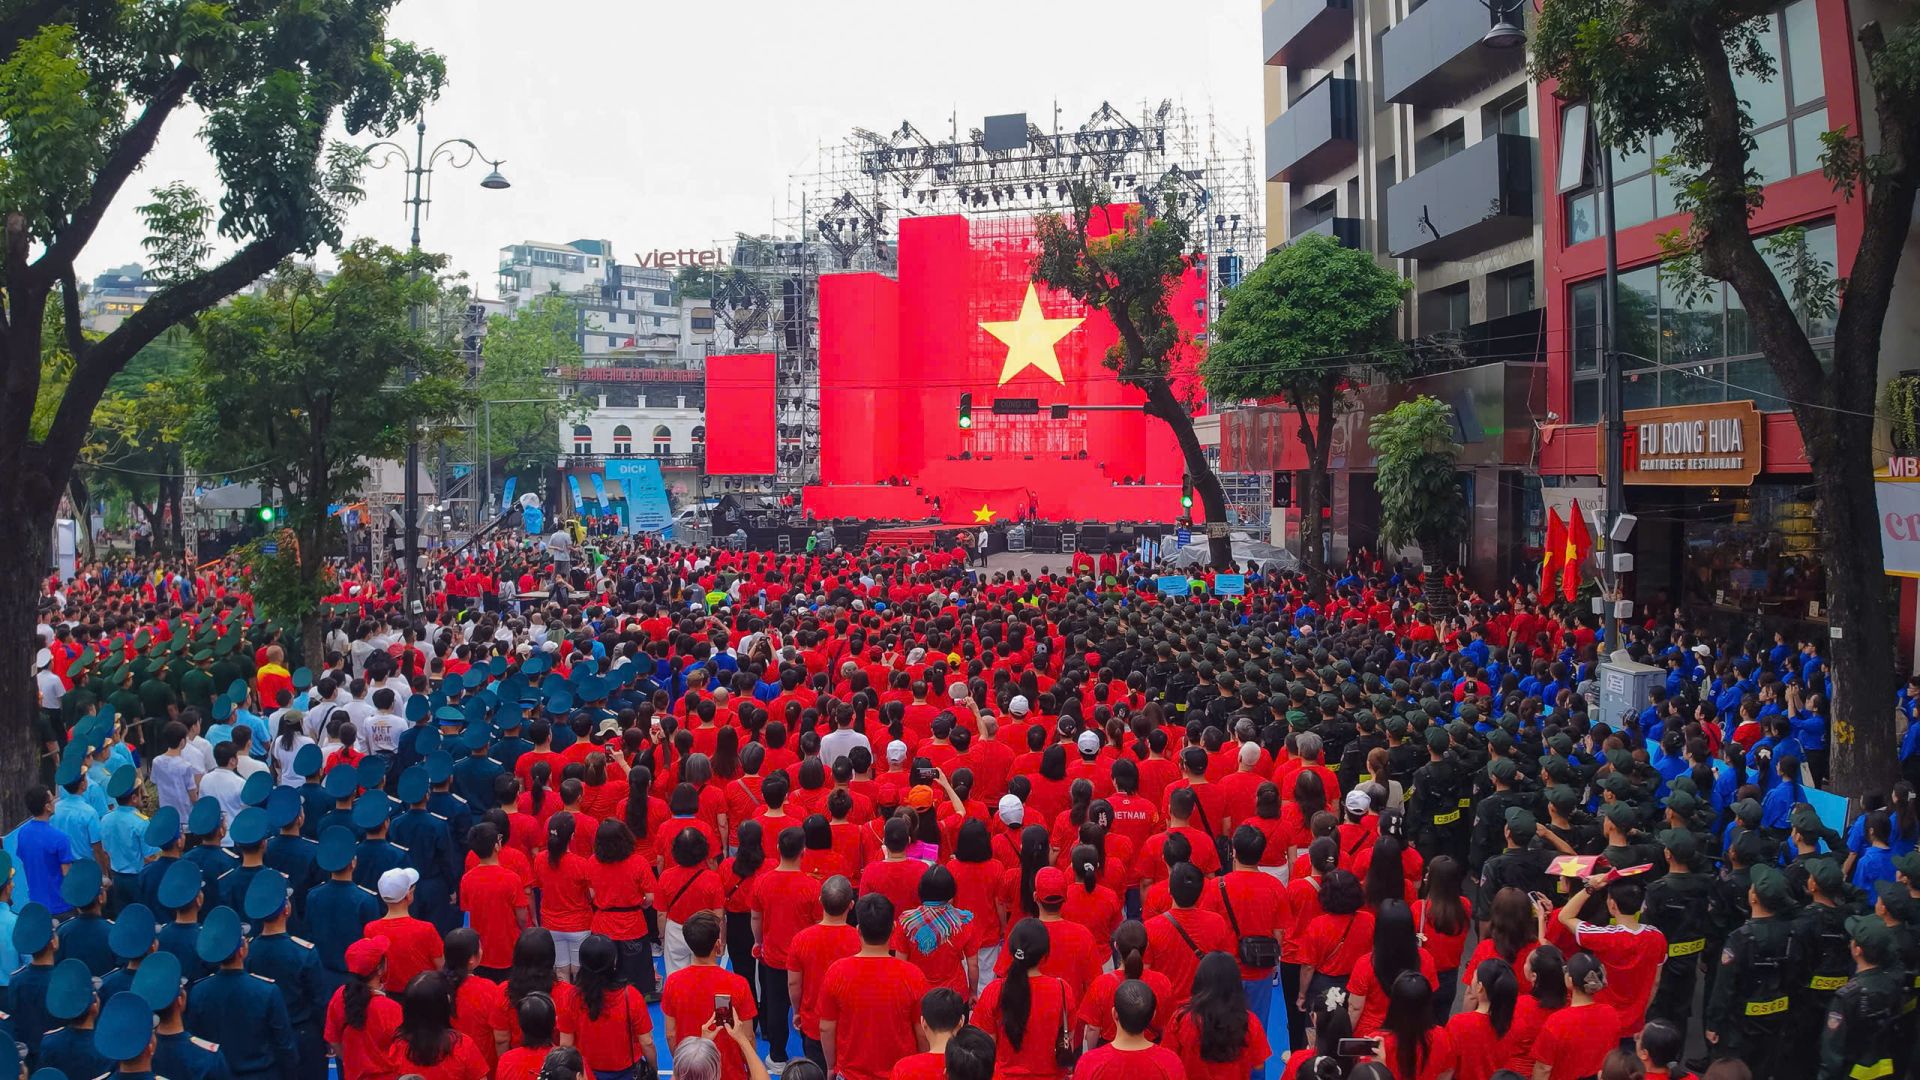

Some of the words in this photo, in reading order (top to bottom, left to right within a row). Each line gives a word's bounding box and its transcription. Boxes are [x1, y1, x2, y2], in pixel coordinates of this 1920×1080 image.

[634, 248, 727, 269] viettel
[1640, 422, 1660, 455] FU
[1663, 420, 1705, 454] RONG
[1709, 418, 1744, 452] HUA
[1640, 459, 1685, 470] CANTONESE
[1687, 458, 1744, 469] RESTAURANT
[1114, 811, 1146, 820] IETNAM
